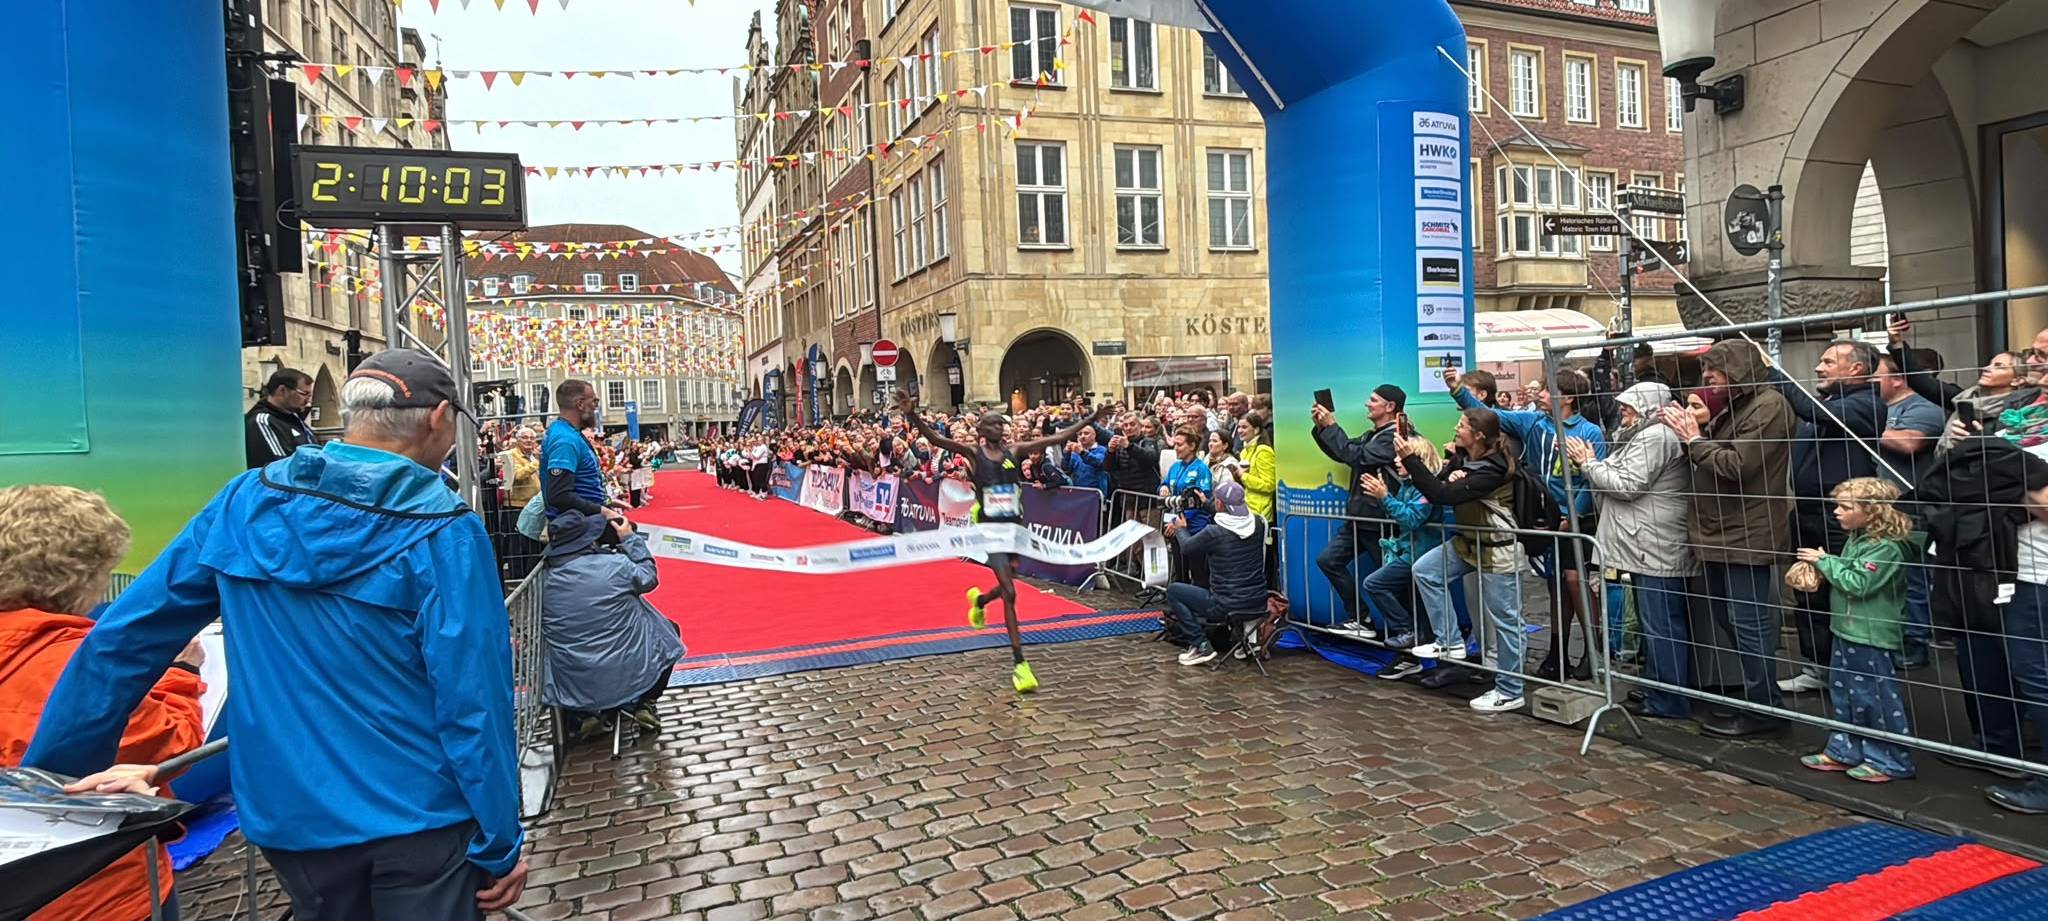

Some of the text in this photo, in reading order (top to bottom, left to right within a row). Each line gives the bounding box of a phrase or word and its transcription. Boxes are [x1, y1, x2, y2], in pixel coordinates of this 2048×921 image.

[1419, 143, 1450, 158] HWK
[311, 162, 506, 206] 2:10:03
[1185, 313, 1266, 336] KÖSTE
